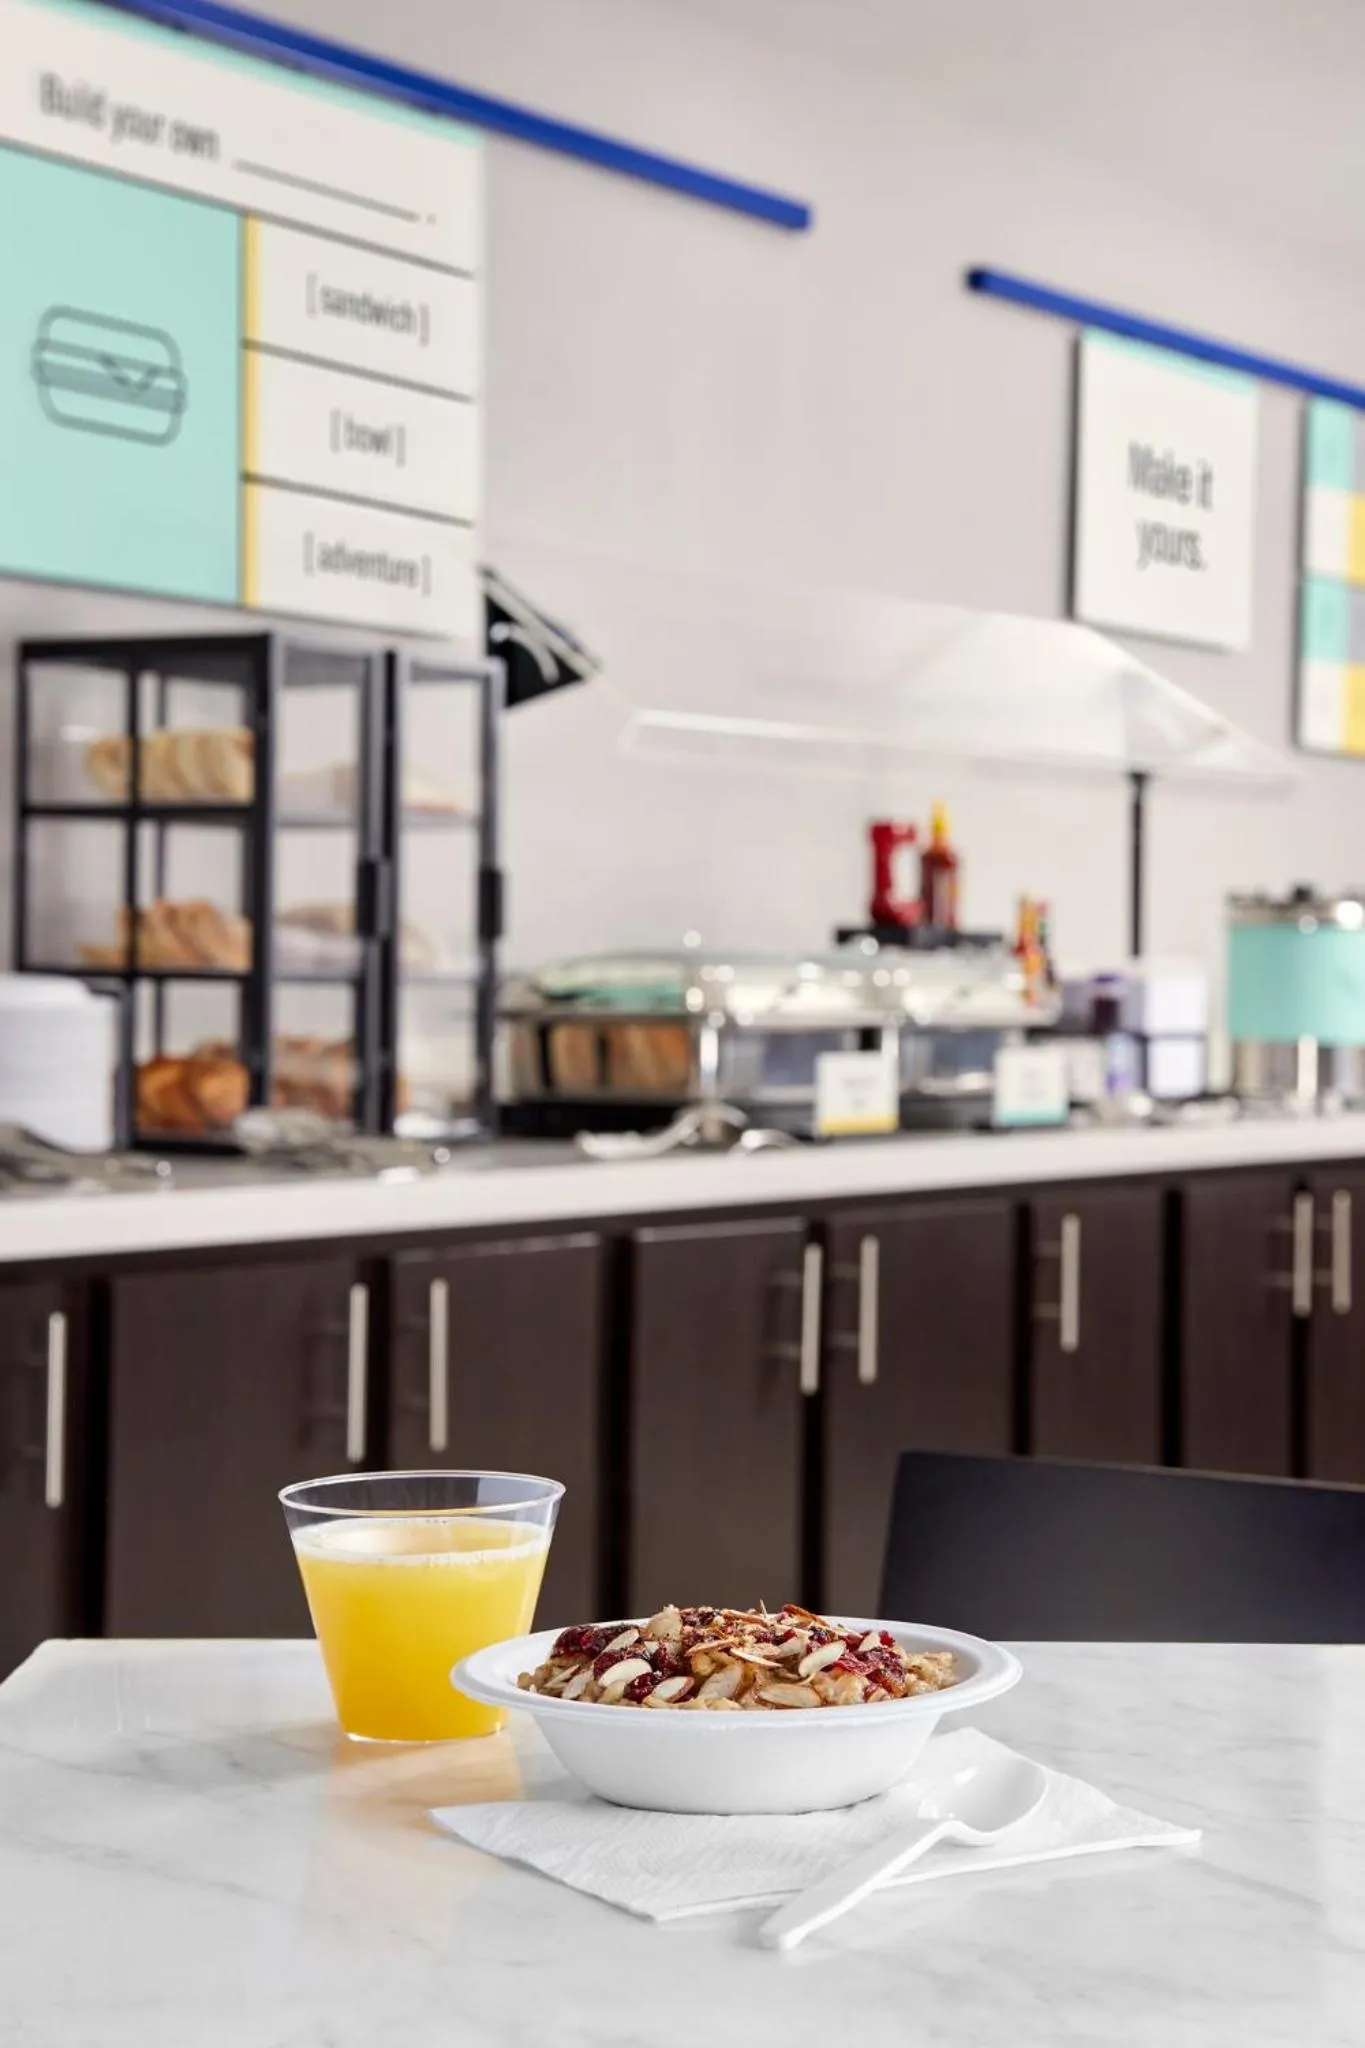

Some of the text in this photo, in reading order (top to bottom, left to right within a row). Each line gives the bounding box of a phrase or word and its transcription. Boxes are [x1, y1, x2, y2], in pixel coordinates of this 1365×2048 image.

[38, 71, 221, 165] Build your own
[1127, 441, 1215, 511] Make it
[1135, 519, 1208, 571] yours.
